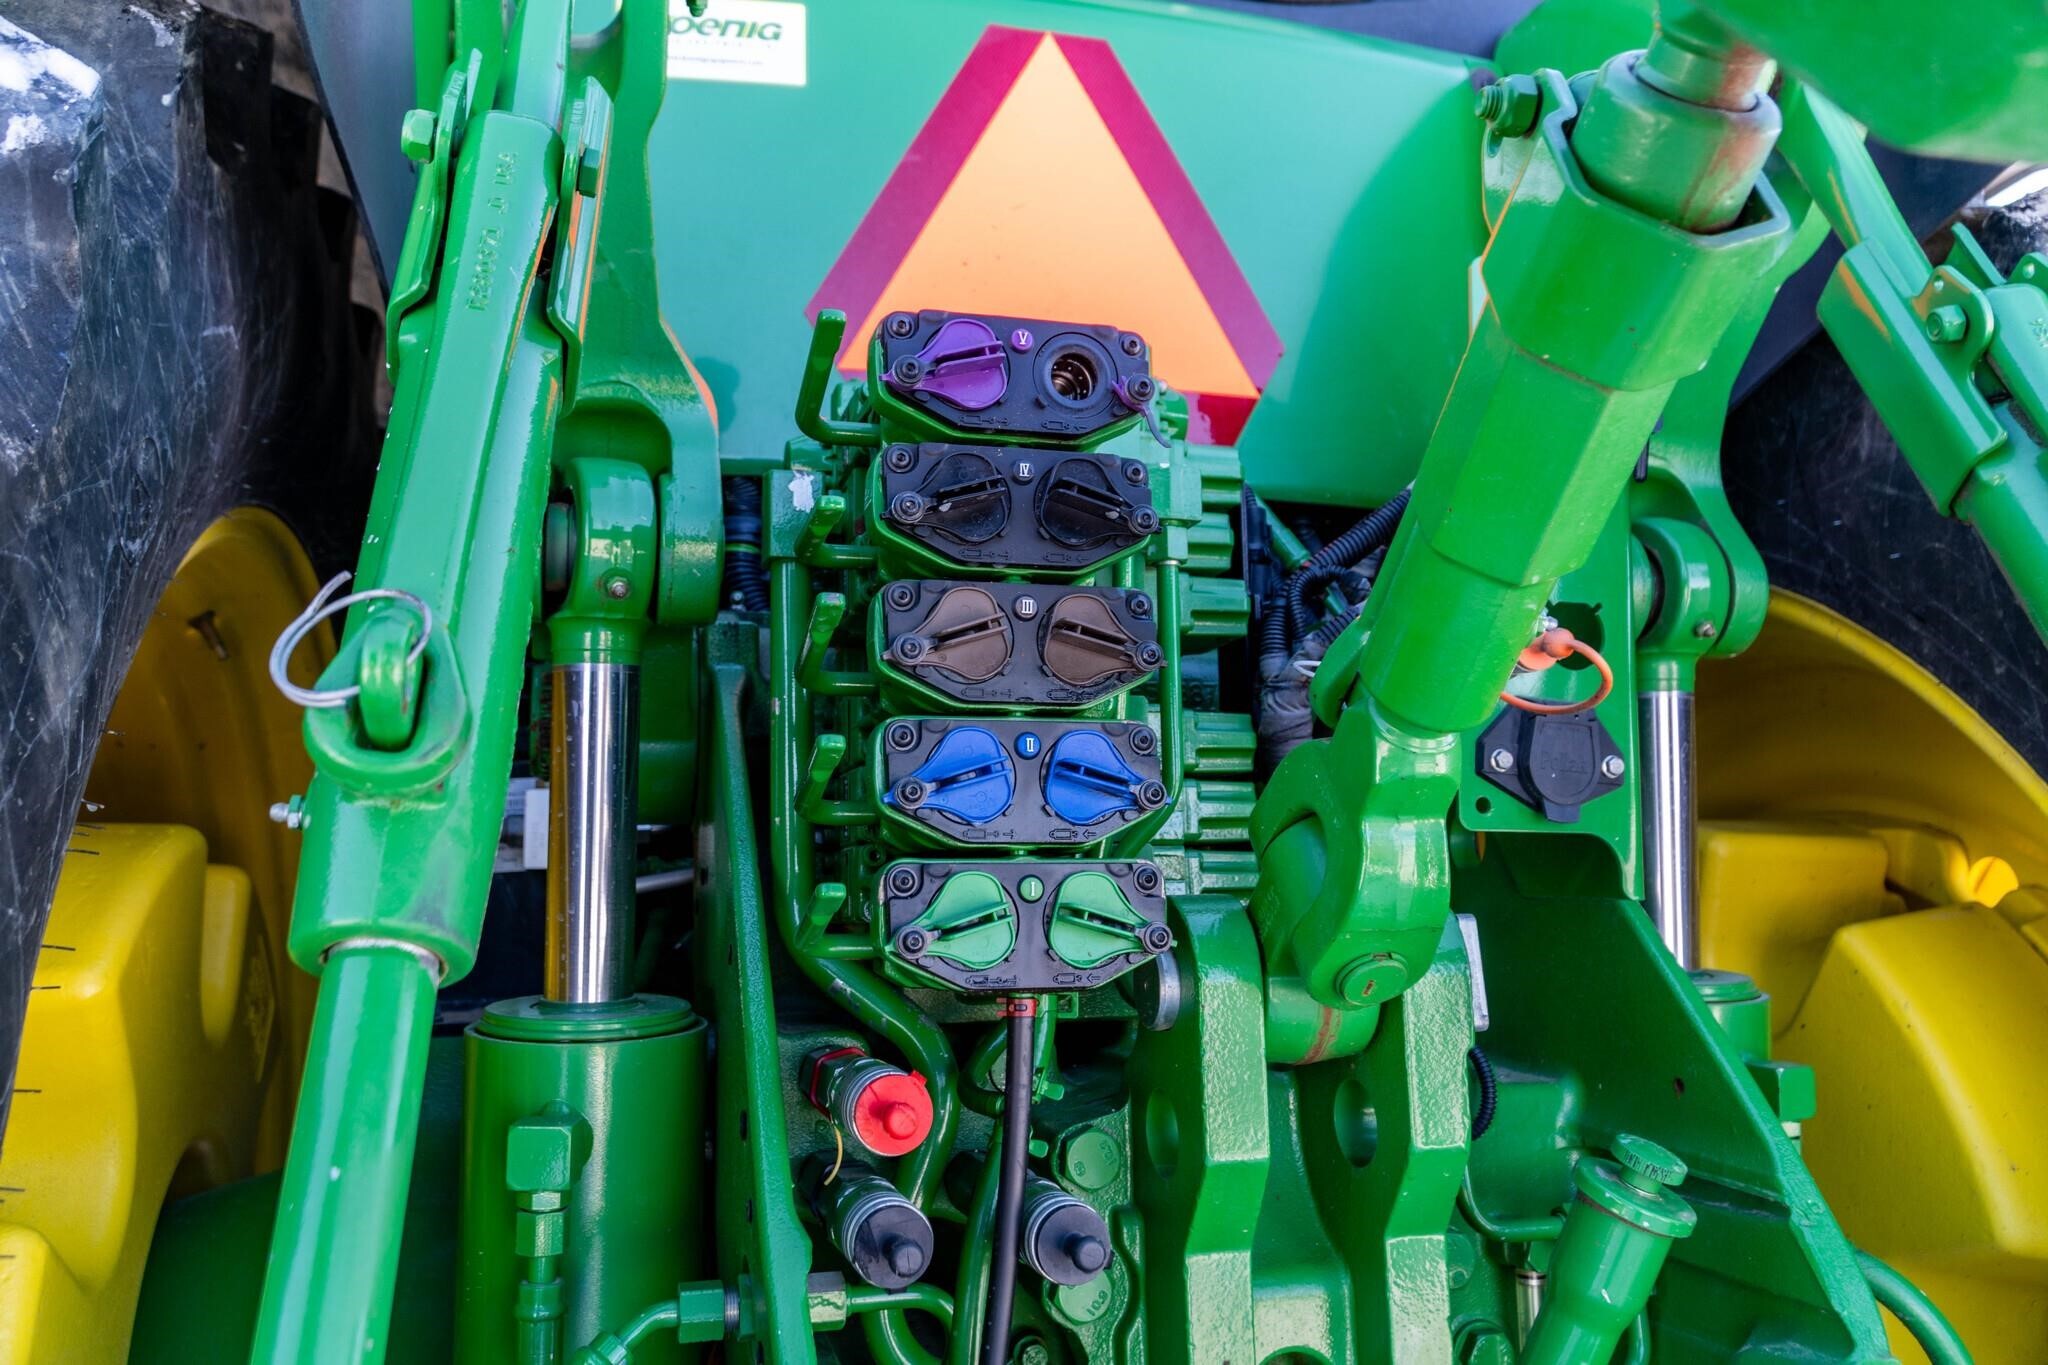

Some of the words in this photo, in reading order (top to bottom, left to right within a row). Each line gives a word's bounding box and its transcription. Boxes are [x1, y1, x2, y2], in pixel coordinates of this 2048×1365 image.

[1018, 331, 1028, 344] V
[1020, 463, 1030, 476] IV
[1021, 599, 1033, 613] III
[1026, 737, 1034, 752] II
